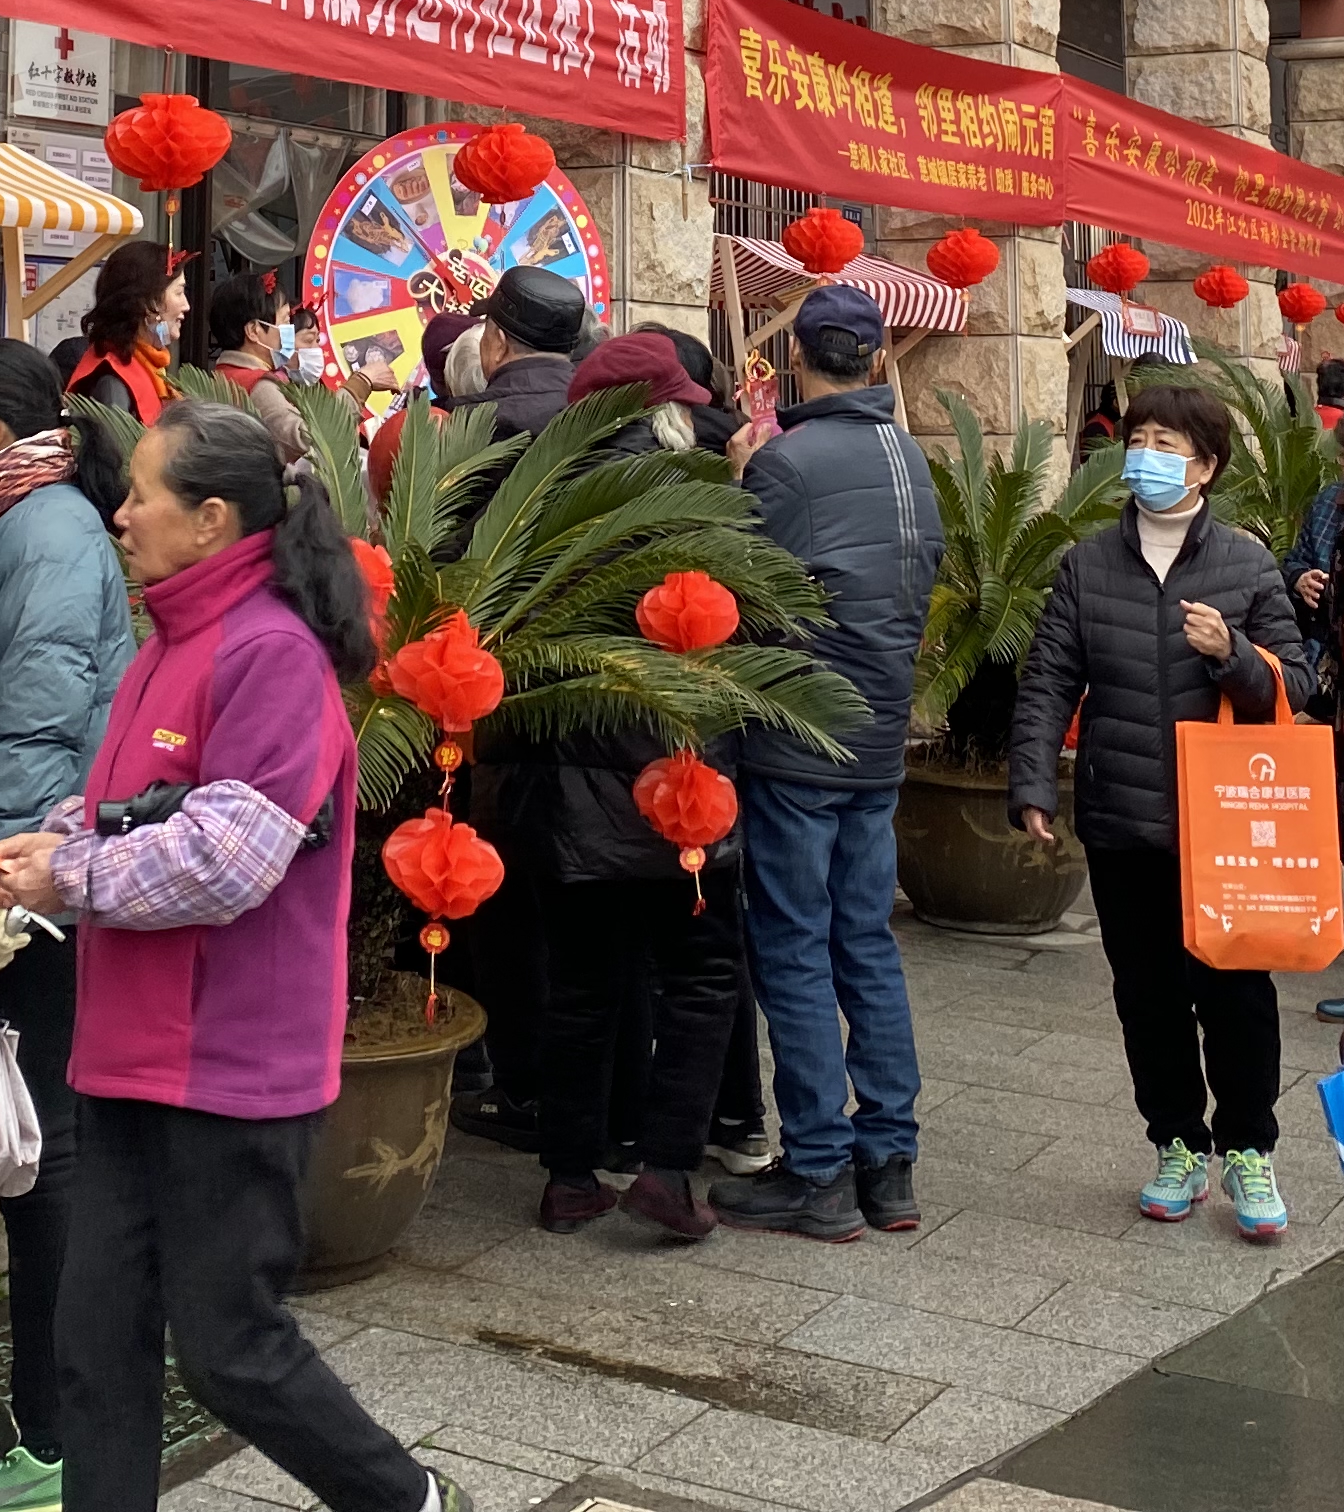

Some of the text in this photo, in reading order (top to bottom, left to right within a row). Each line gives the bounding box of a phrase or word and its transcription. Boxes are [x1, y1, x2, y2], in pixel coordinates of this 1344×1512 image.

[28, 61, 98, 88] 红十字救护站
[739, 27, 1056, 161] 喜乐安康吟相逢，邻里相约闹元宵
